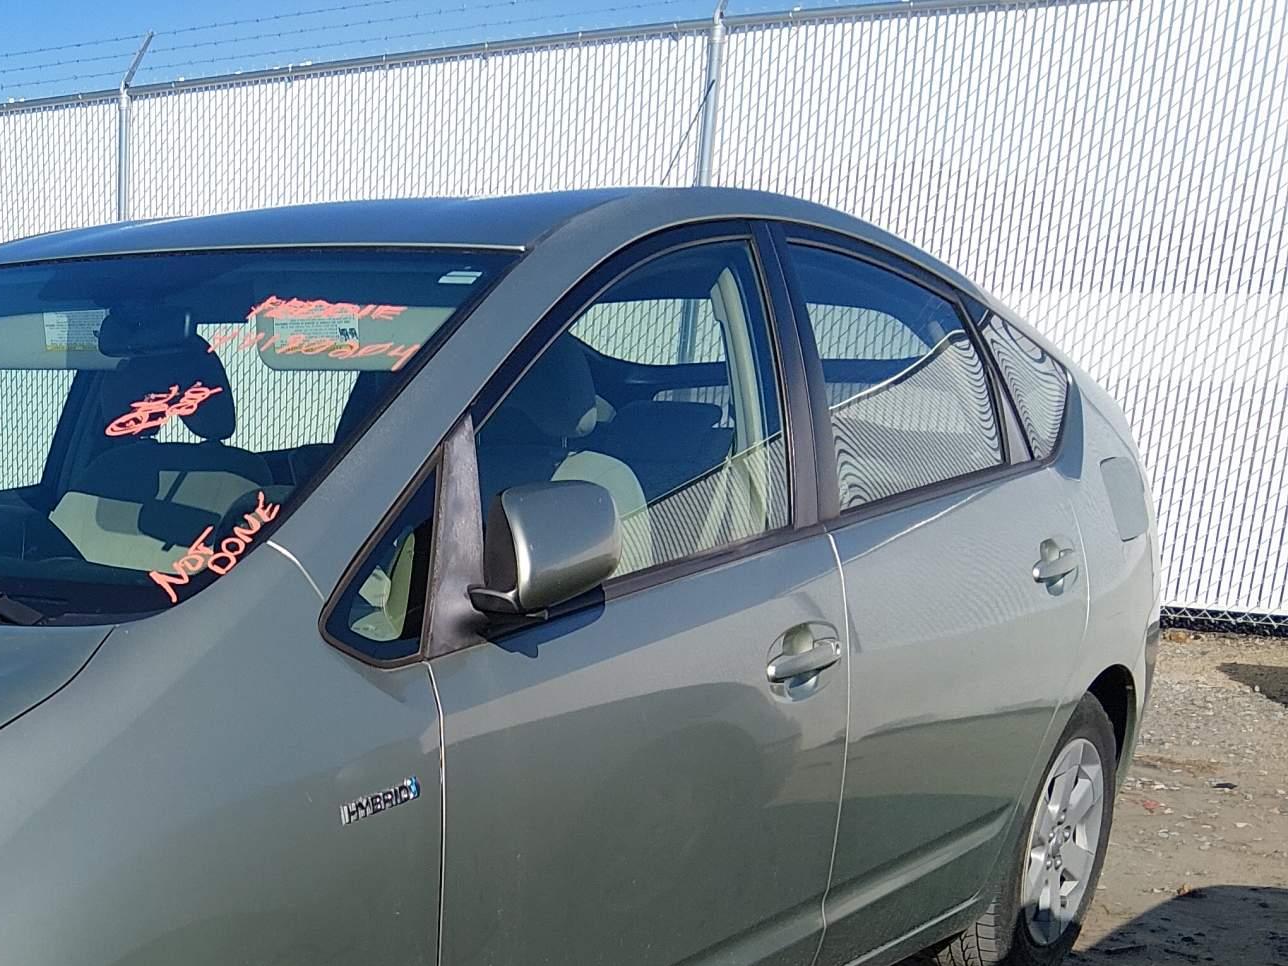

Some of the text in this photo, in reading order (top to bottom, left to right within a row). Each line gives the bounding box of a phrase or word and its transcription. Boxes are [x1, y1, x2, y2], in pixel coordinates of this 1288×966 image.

[149, 524, 215, 603] NOT
[207, 490, 280, 575] DONE
[339, 781, 411, 825] HYBRID
